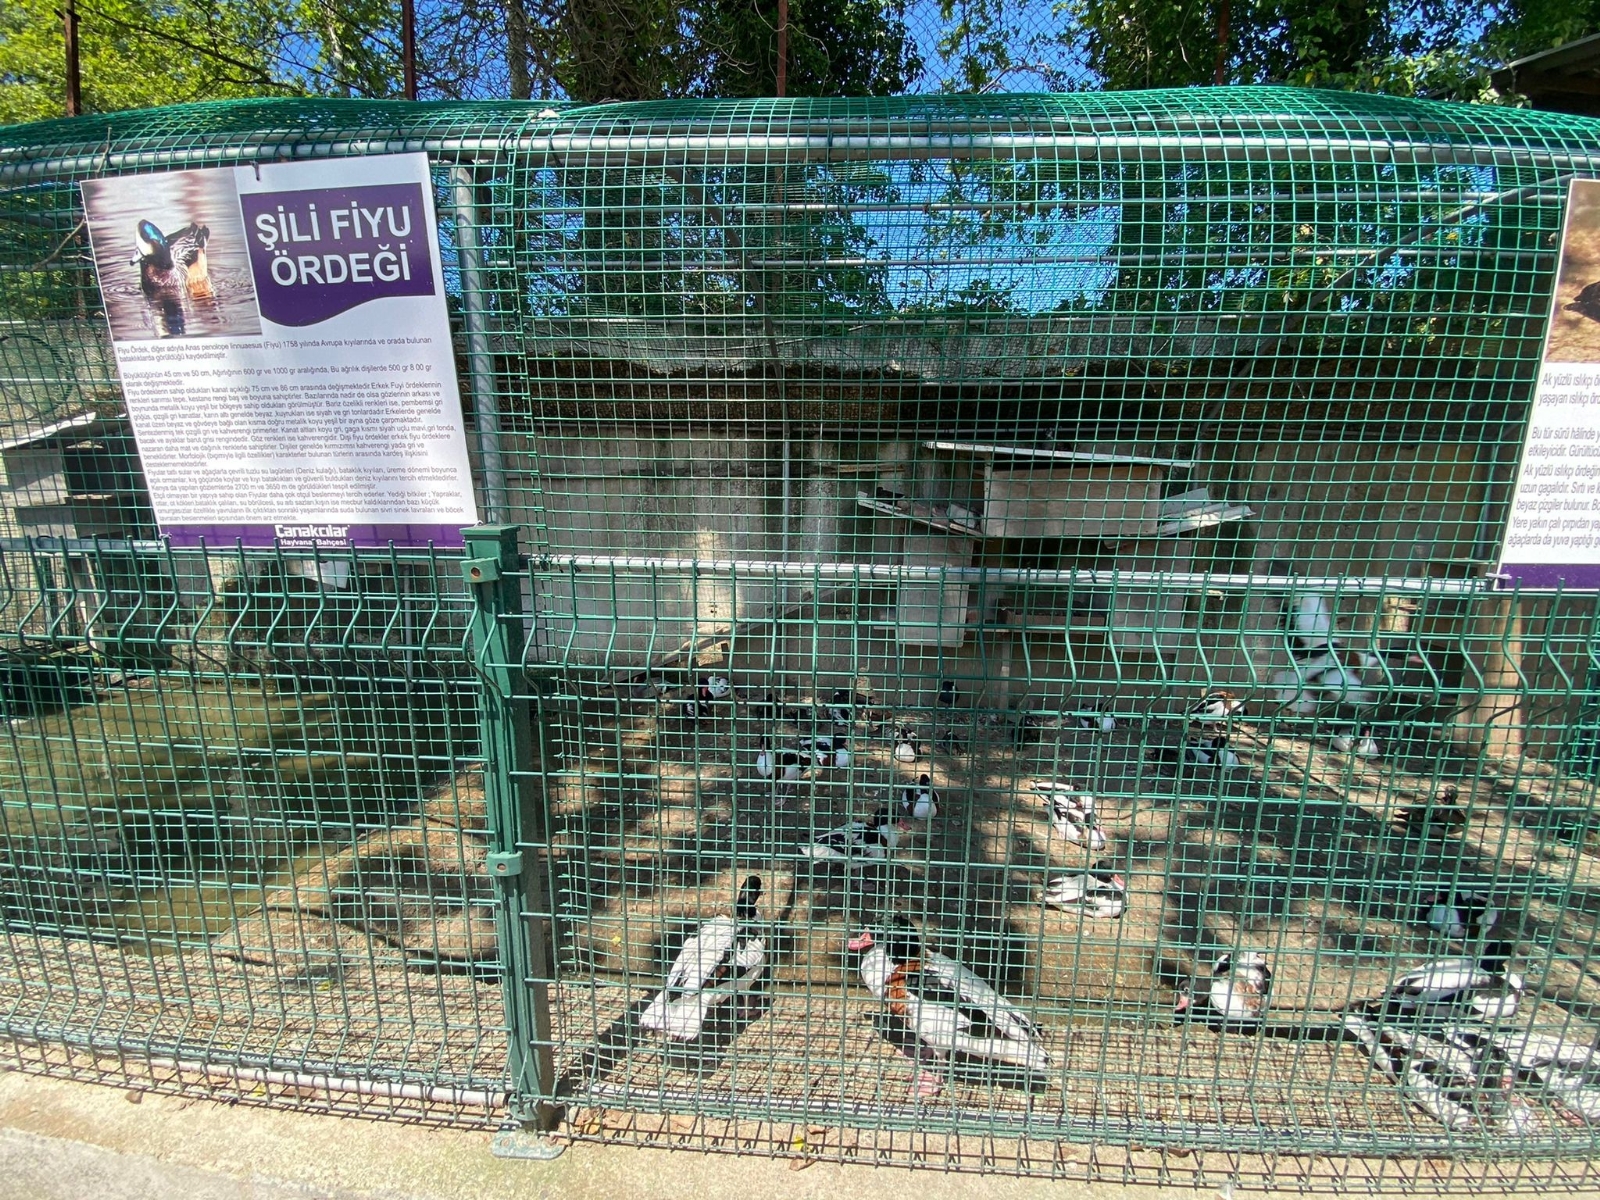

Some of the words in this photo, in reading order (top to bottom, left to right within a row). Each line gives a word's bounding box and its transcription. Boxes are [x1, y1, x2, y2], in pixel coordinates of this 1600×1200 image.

[256, 204, 320, 251] ŞİLİ
[330, 201, 411, 240] FİYU
[271, 243, 410, 286] ÖRDEĞİ
[1542, 373, 1552, 385] Ak
[1532, 426, 1541, 439] Bu
[1523, 464, 1534, 476] Ak
[1520, 483, 1537, 493] uzun
[1587, 484, 1596, 494] ve
[1516, 499, 1538, 513] beyaz
[1512, 516, 1528, 528] Yere
[316, 539, 346, 547] Bahçesi
[1543, 534, 1552, 545] da
